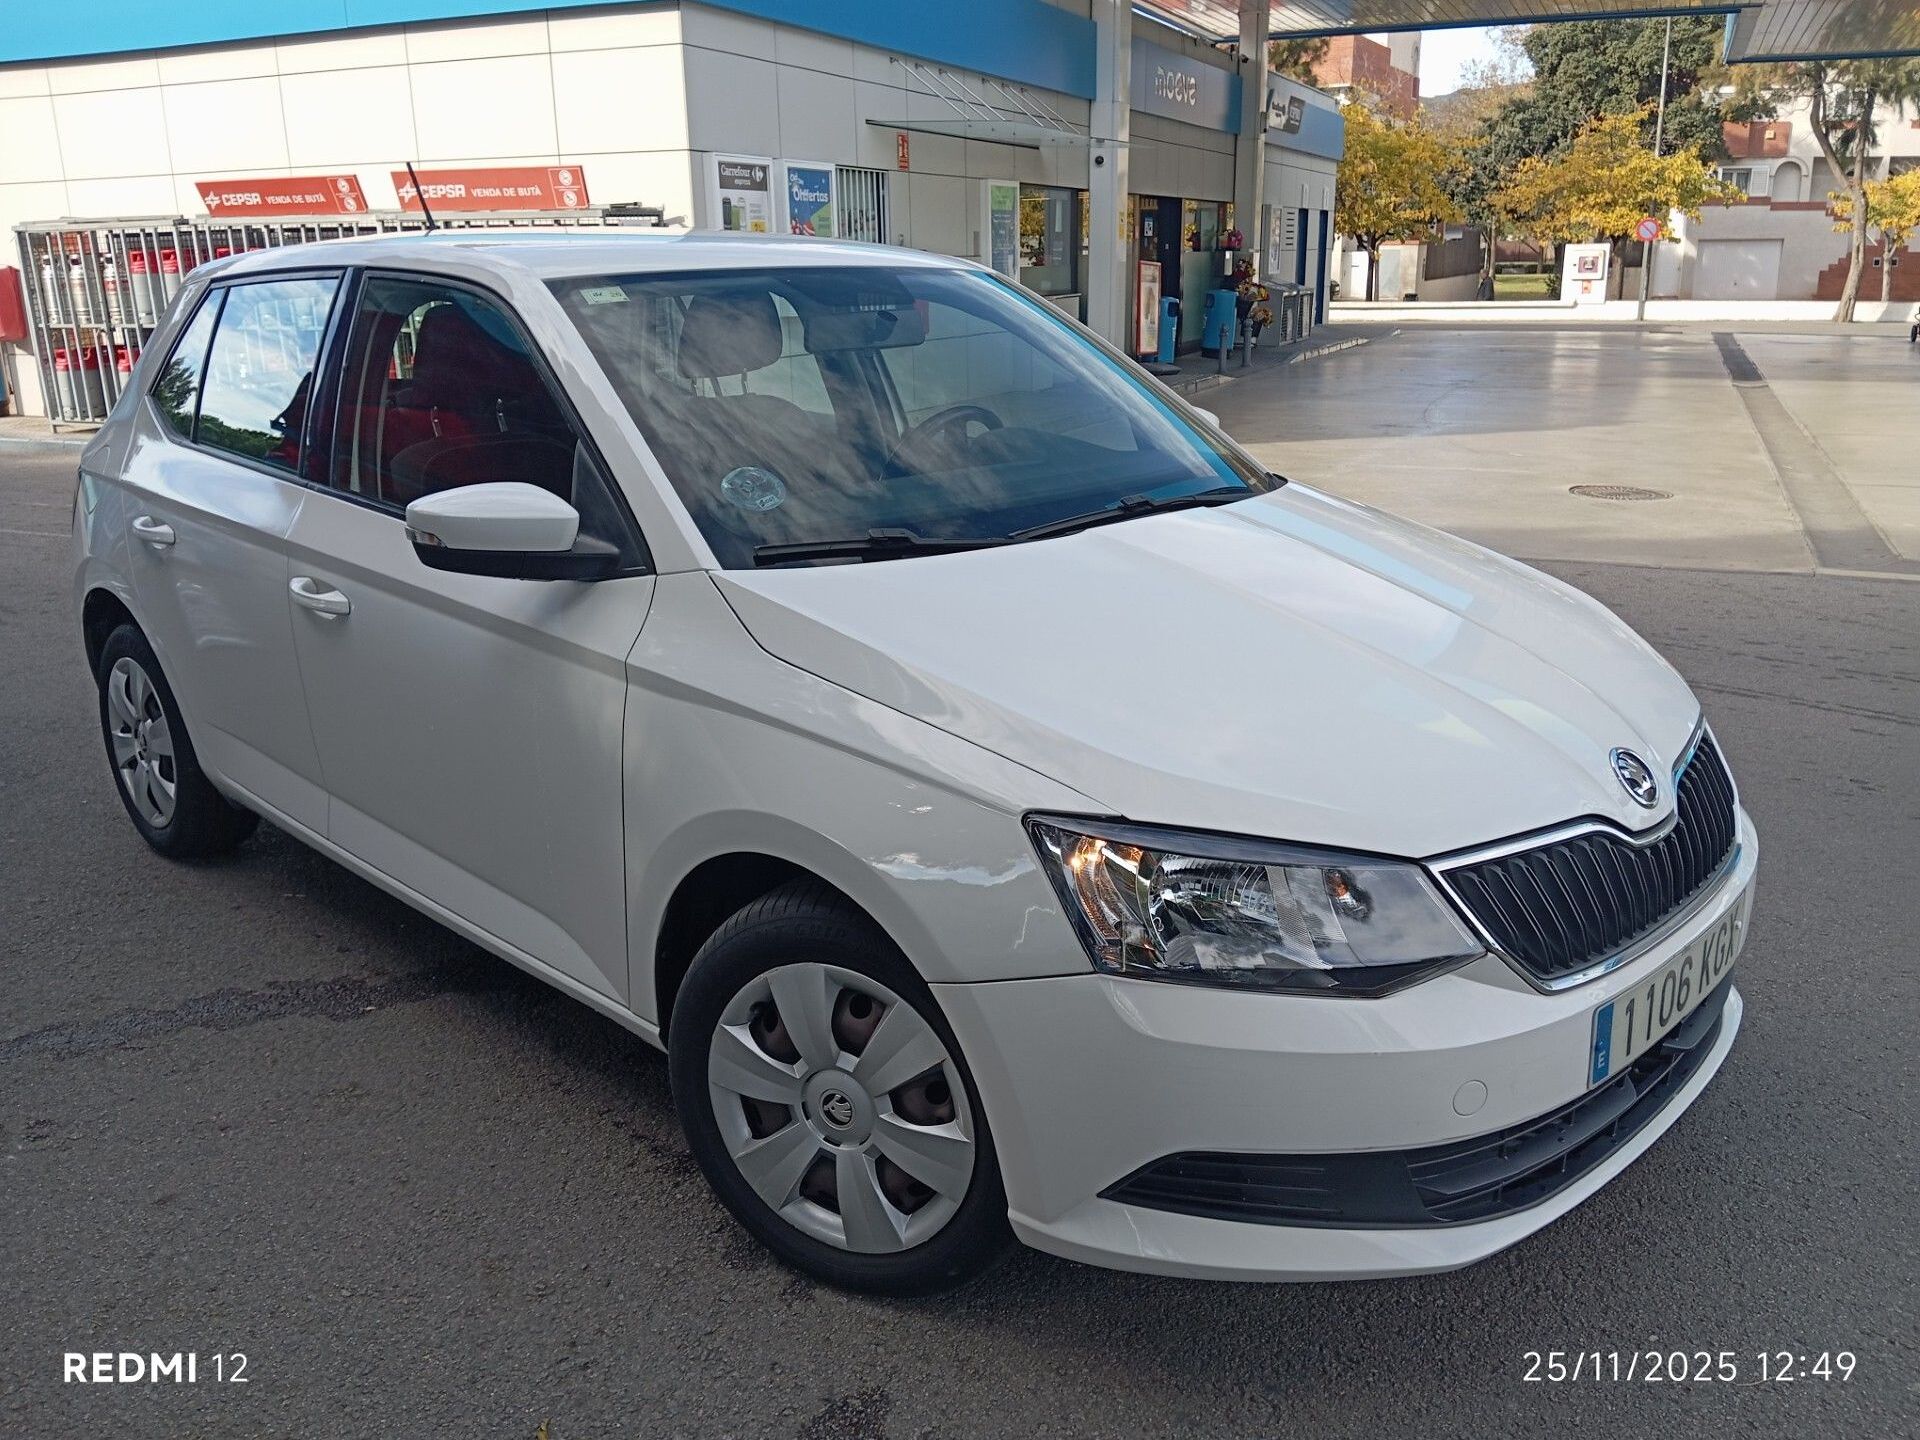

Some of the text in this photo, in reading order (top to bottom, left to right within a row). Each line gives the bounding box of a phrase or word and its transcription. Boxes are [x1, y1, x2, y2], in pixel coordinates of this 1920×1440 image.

[1155, 66, 1196, 106] moeve
[721, 164, 751, 178] Carrefour
[222, 192, 262, 206] CEPSA
[265, 195, 292, 205] VENDA
[292, 194, 303, 204] DE
[421, 184, 466, 199] CEPSA
[471, 188, 501, 198] VENDA
[502, 187, 517, 197] DE
[1625, 904, 1739, 1057] 1106 KGX
[1597, 1051, 1605, 1069] E
